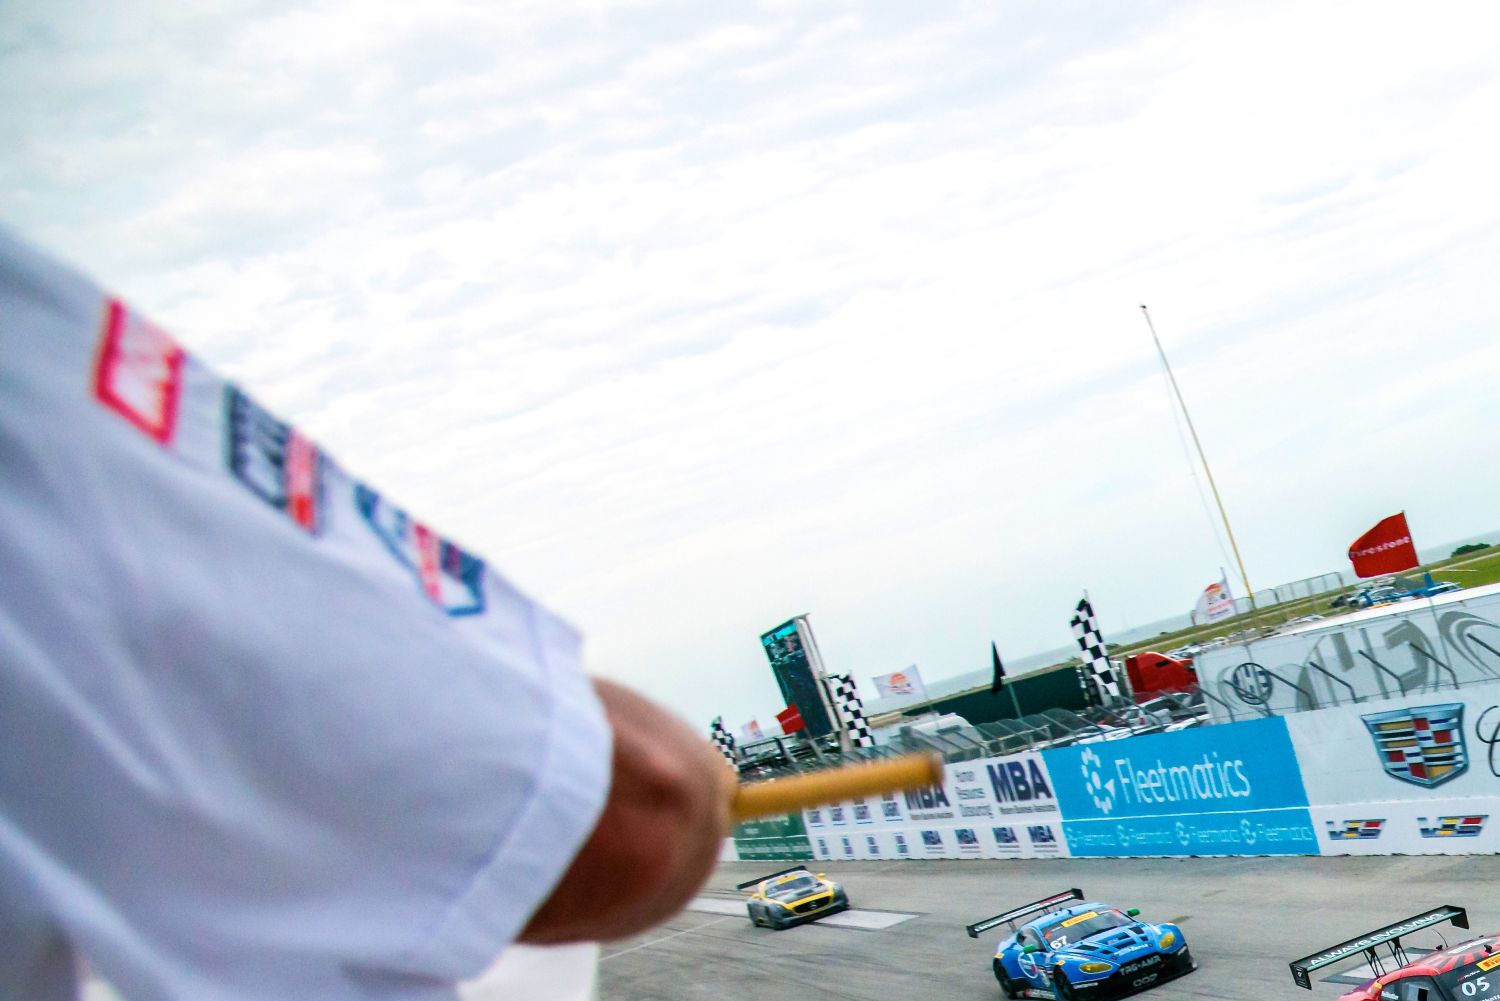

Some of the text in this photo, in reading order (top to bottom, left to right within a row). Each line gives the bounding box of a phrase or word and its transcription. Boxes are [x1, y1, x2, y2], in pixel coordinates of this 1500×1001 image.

[1349, 535, 1411, 559] Firestone
[986, 758, 1053, 804] MBA
[1114, 751, 1252, 805] Fleetmatics
[1051, 935, 1069, 950] 67
[1310, 939, 1370, 966] ALWAYS
[1461, 976, 1491, 997] 05
